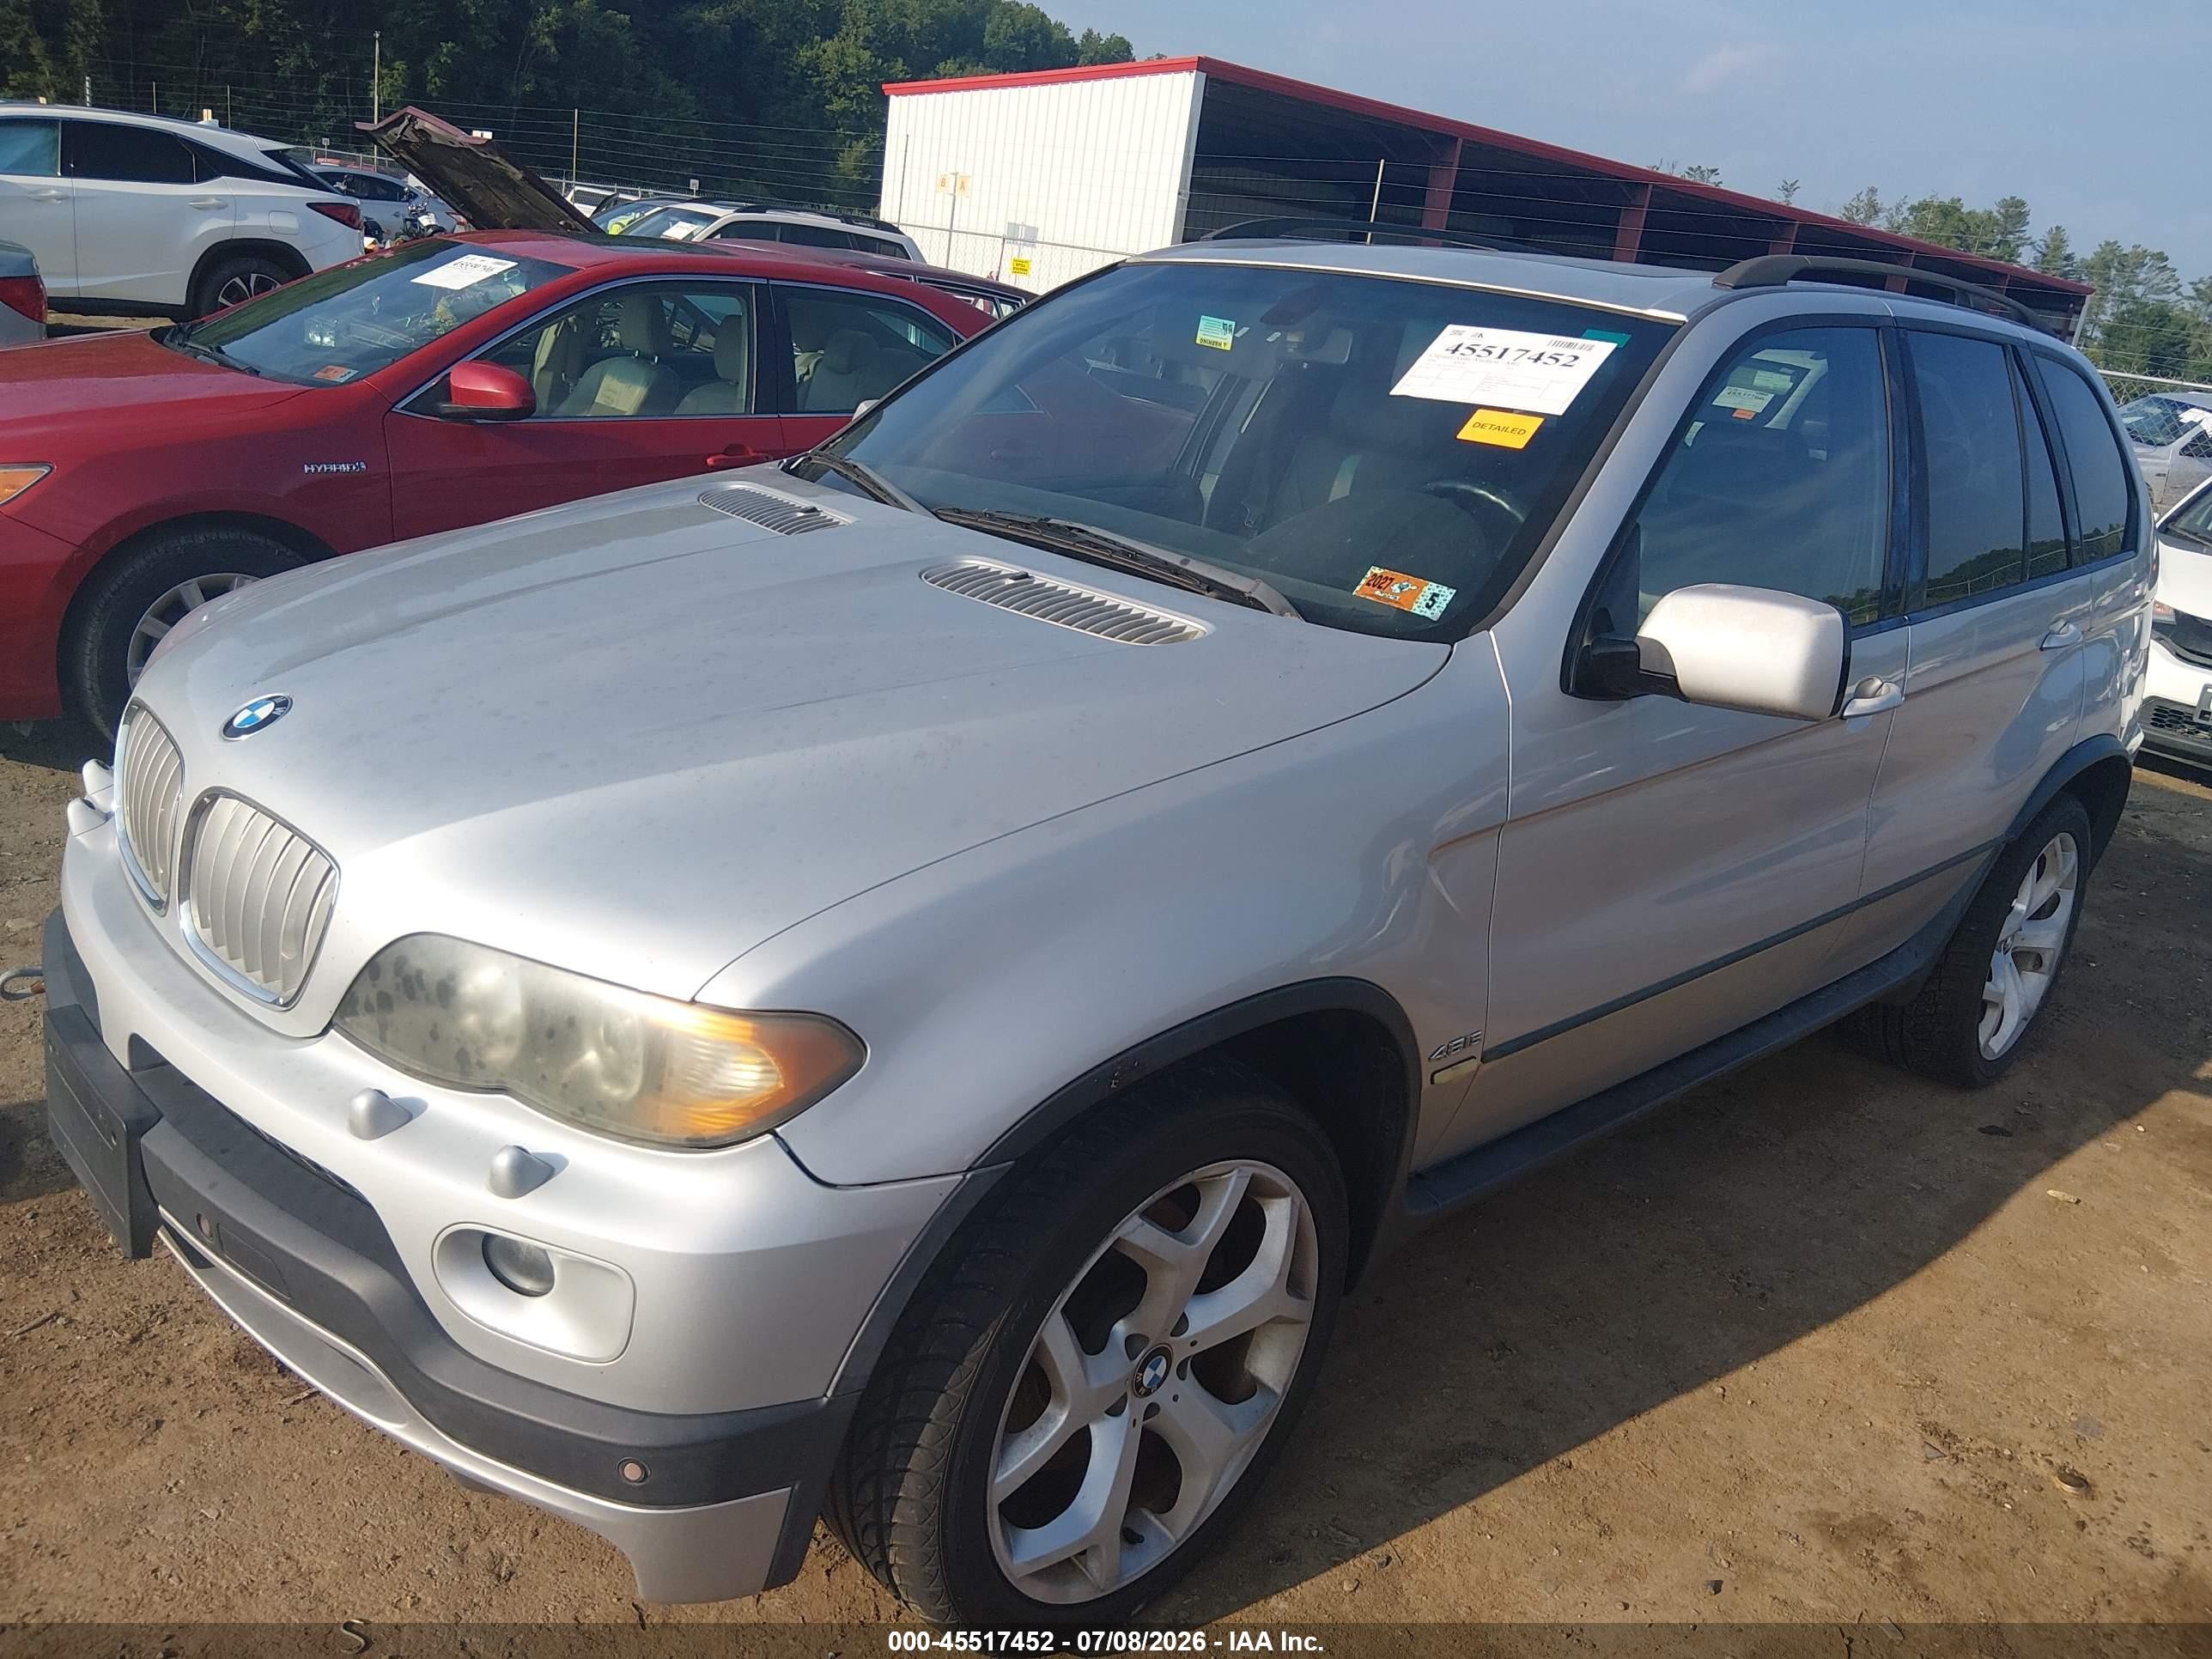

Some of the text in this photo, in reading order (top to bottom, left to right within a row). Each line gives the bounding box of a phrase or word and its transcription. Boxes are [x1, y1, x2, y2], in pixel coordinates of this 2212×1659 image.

[1444, 342, 1580, 368] 45517452
[1472, 421, 1527, 436] DETAILED
[304, 464, 356, 473] HYBRID
[1365, 574, 1395, 591] 2027
[1425, 592, 1440, 609] 5
